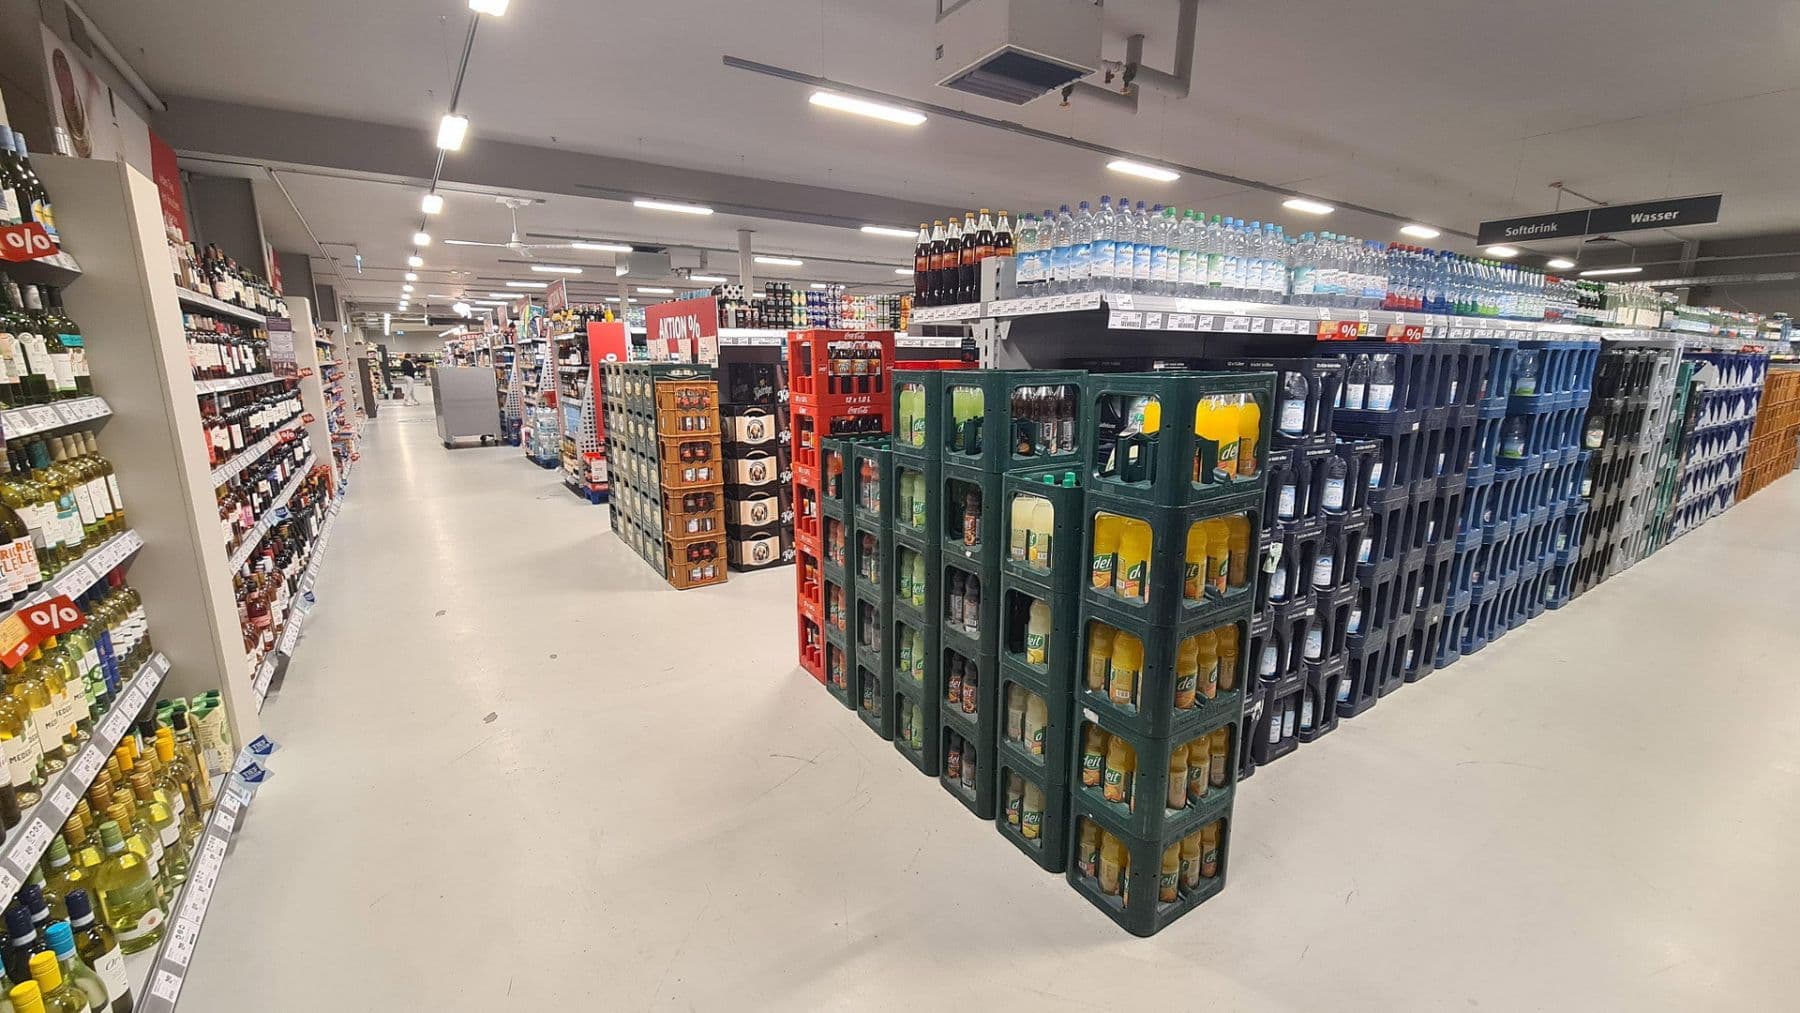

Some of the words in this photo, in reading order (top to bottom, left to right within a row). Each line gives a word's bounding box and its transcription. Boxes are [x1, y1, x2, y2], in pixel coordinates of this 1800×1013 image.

[1505, 222, 1558, 237] Softdrink
[1630, 209, 1680, 223] Wasser
[6, 228, 50, 254] %
[659, 316, 687, 339] AKTION
[688, 314, 700, 339] %
[1341, 324, 1357, 337] %
[1407, 328, 1421, 340] %
[31, 603, 79, 629] %
